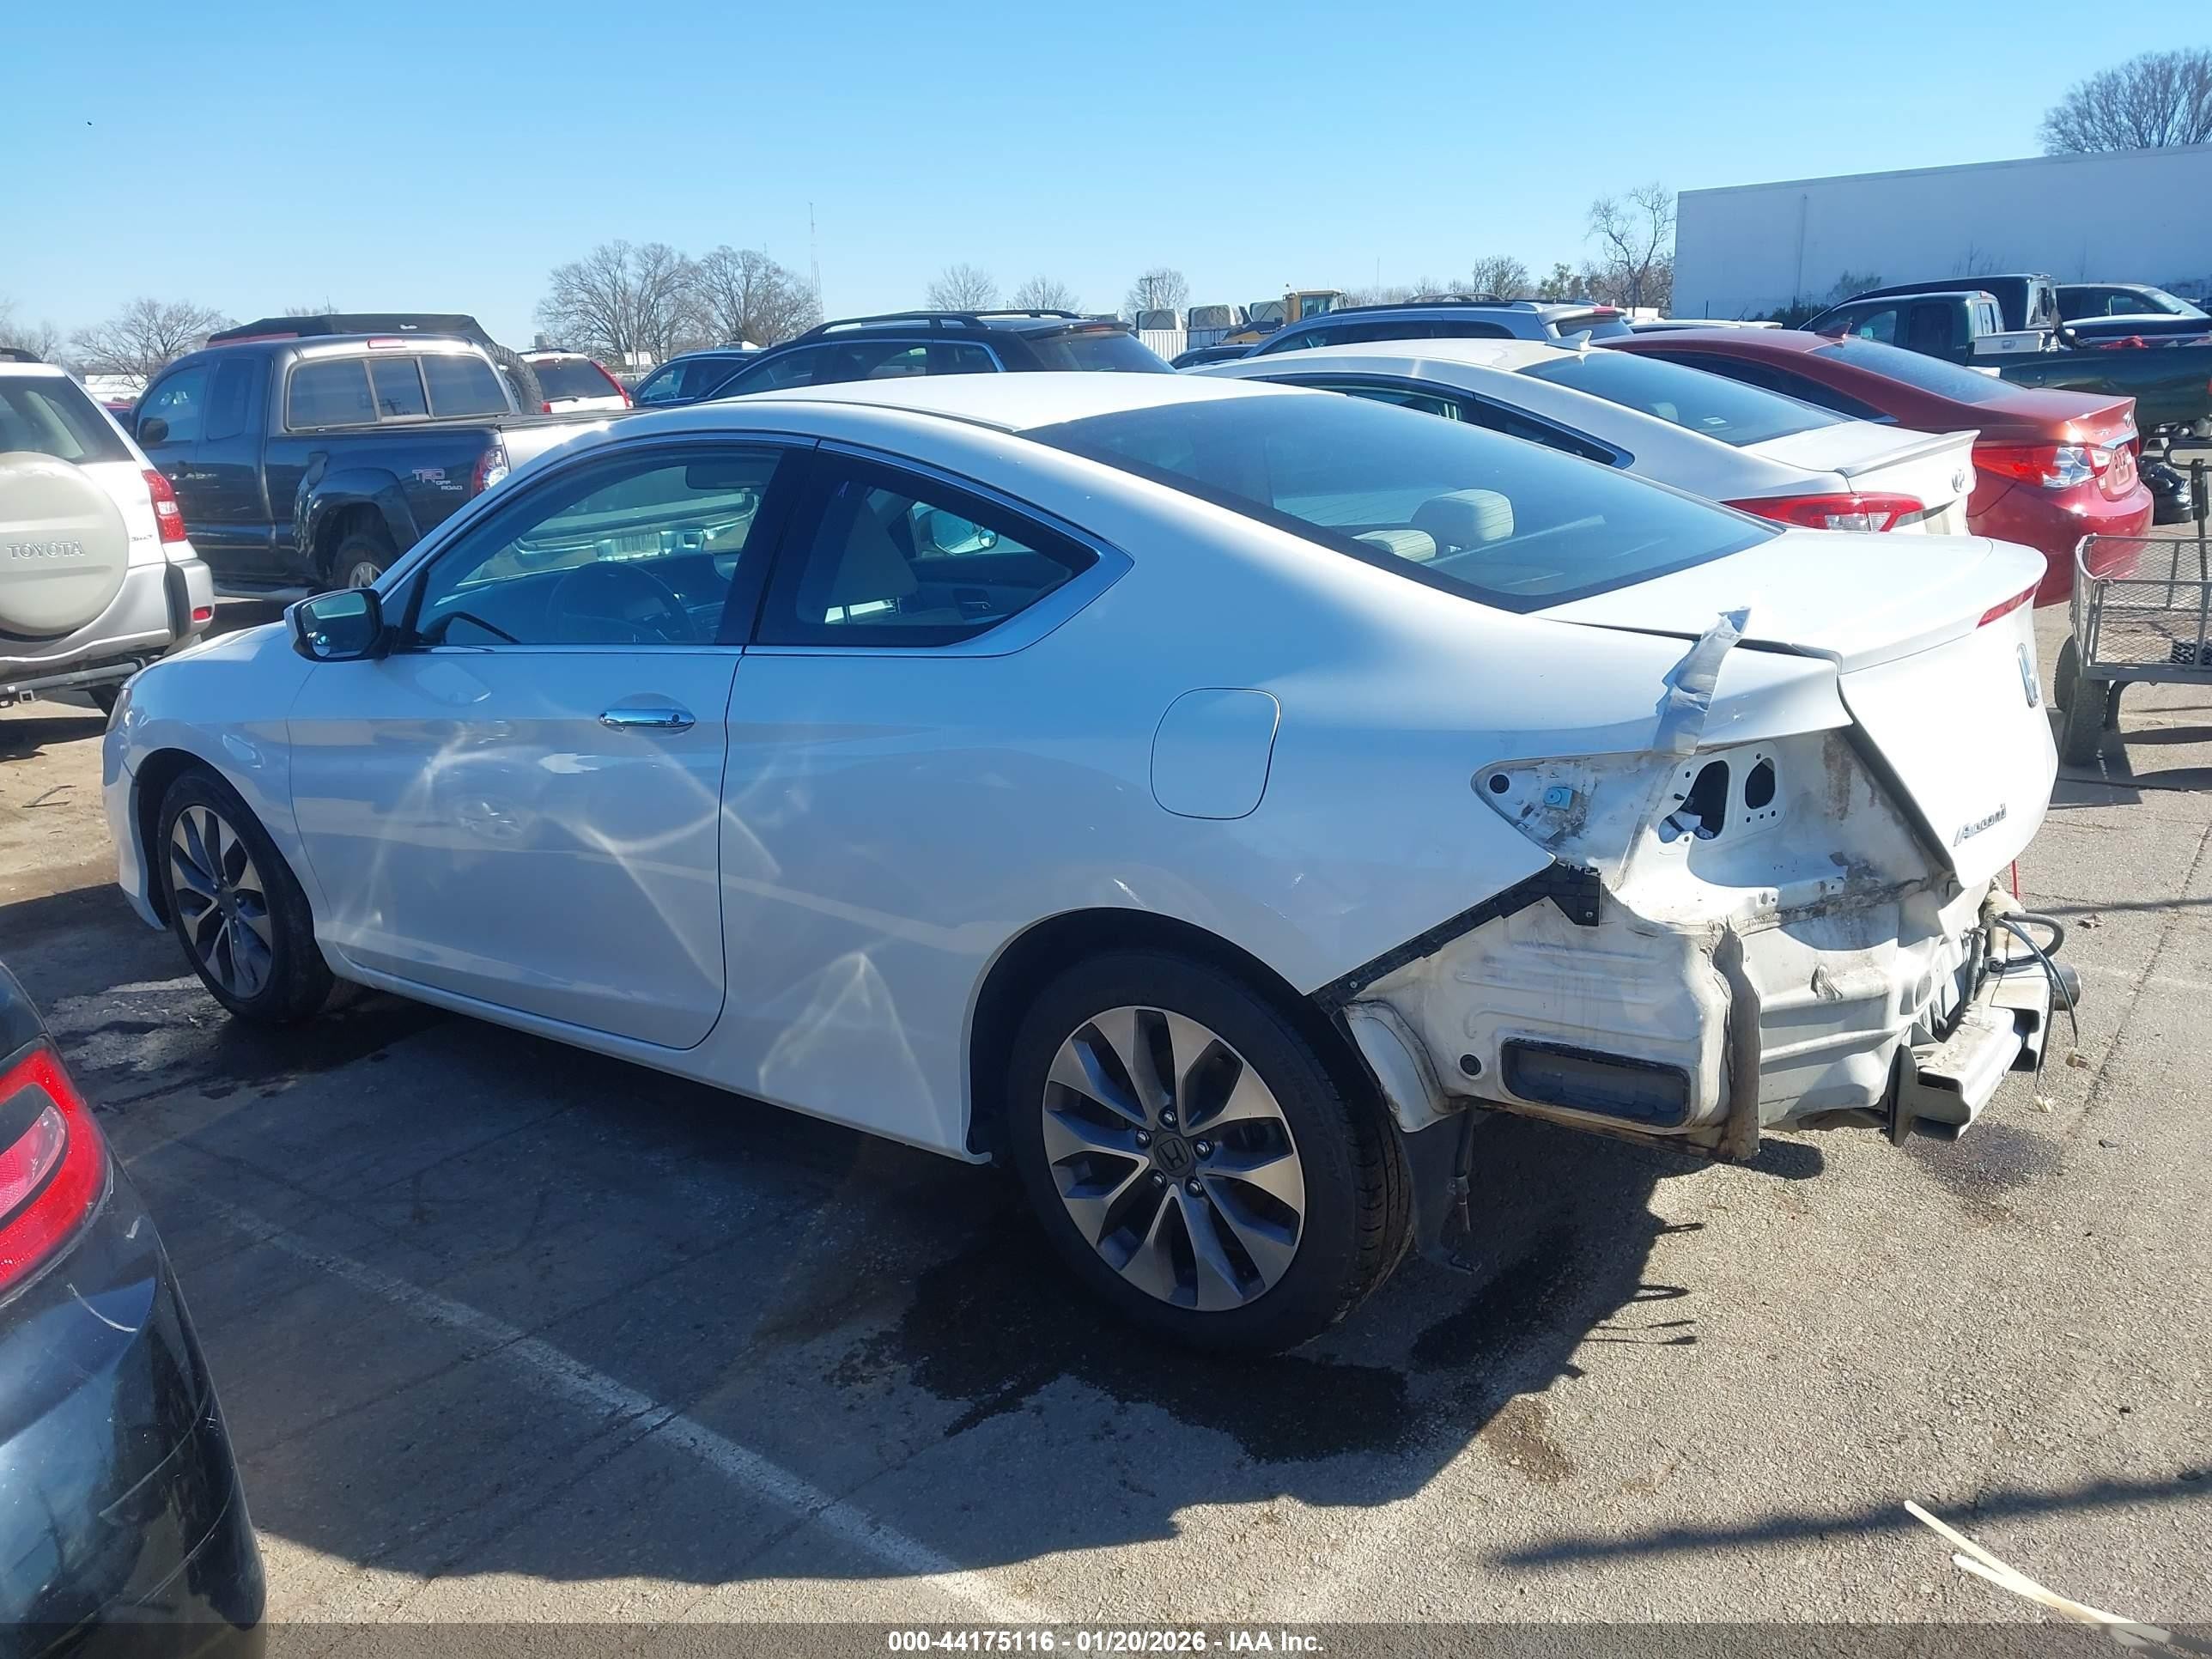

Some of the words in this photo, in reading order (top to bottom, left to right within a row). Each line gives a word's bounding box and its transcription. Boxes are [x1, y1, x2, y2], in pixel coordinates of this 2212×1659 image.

[411, 468, 446, 483] TRD
[6, 540, 85, 560] TOYOTA
[1953, 801, 2007, 848] Accord
